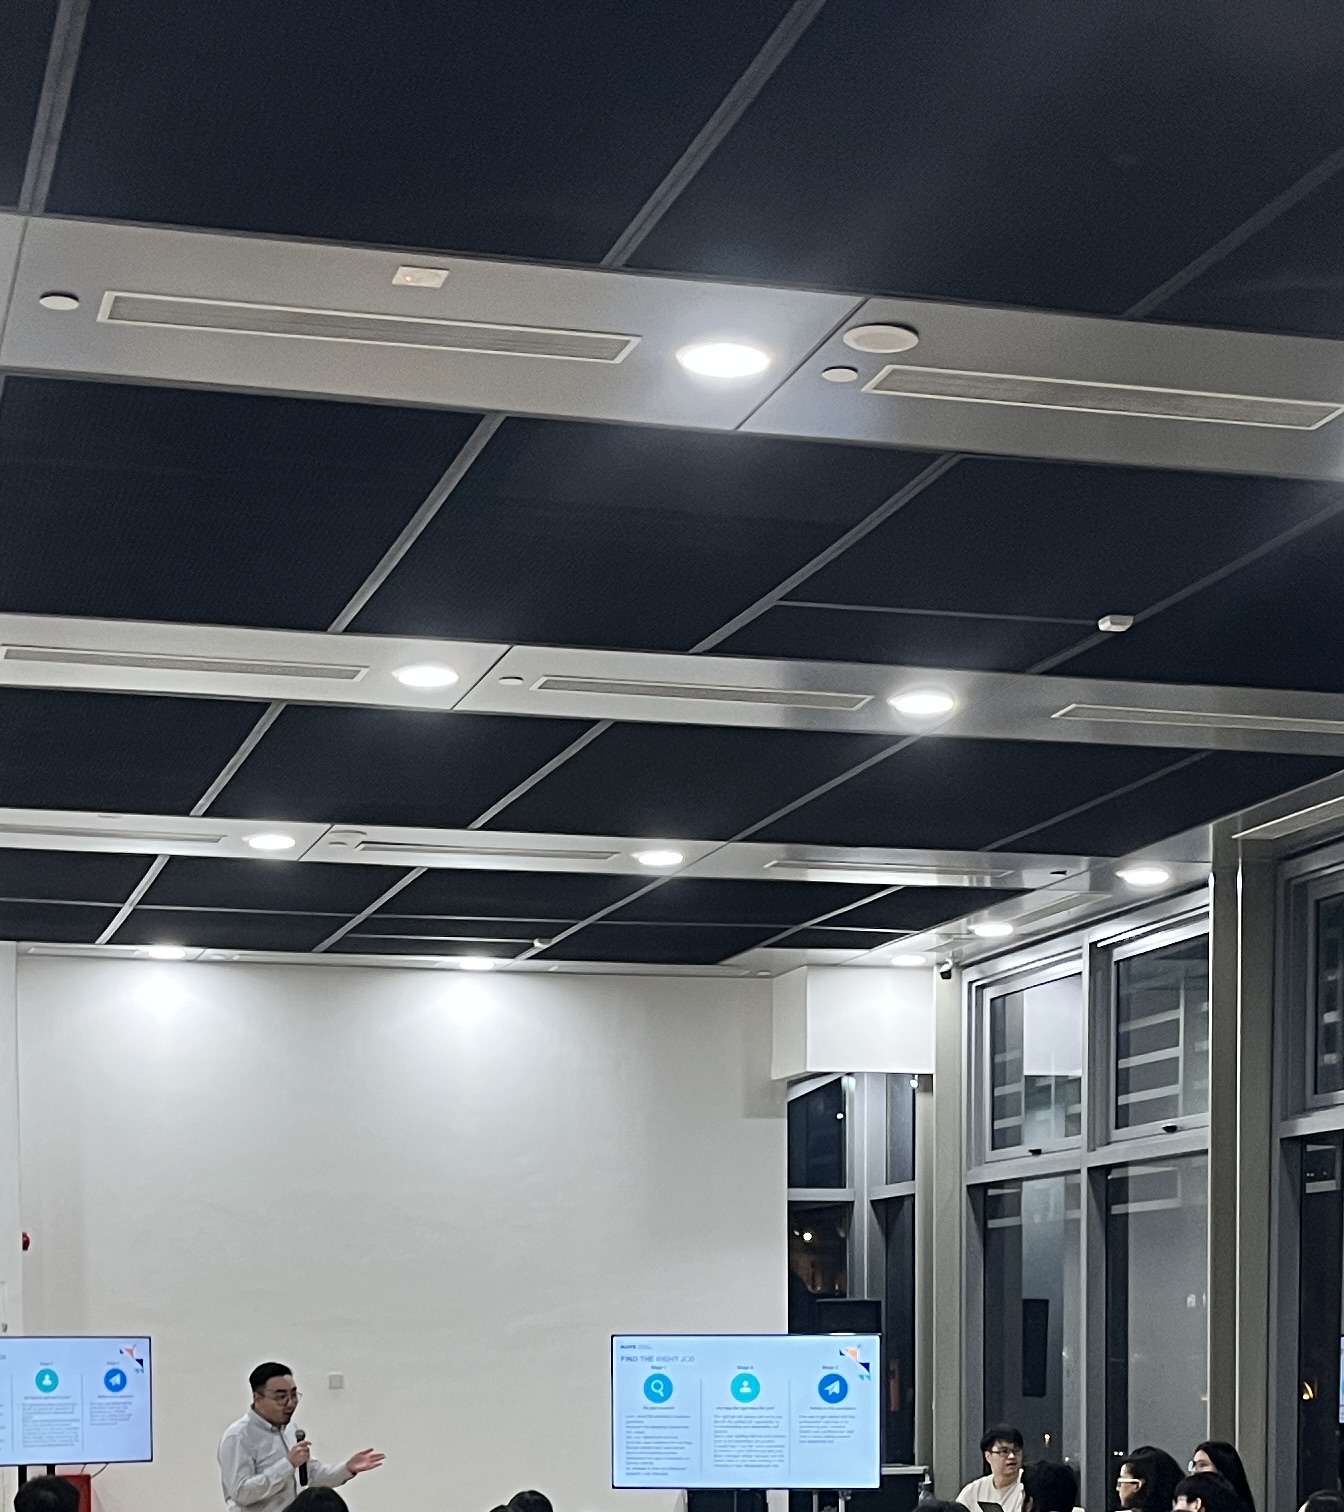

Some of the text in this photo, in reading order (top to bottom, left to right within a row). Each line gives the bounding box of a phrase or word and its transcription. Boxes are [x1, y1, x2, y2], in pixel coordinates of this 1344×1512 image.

[640, 1355, 654, 1363] THE
[656, 1355, 679, 1363] RIGHT
[680, 1355, 696, 1363] JOB
